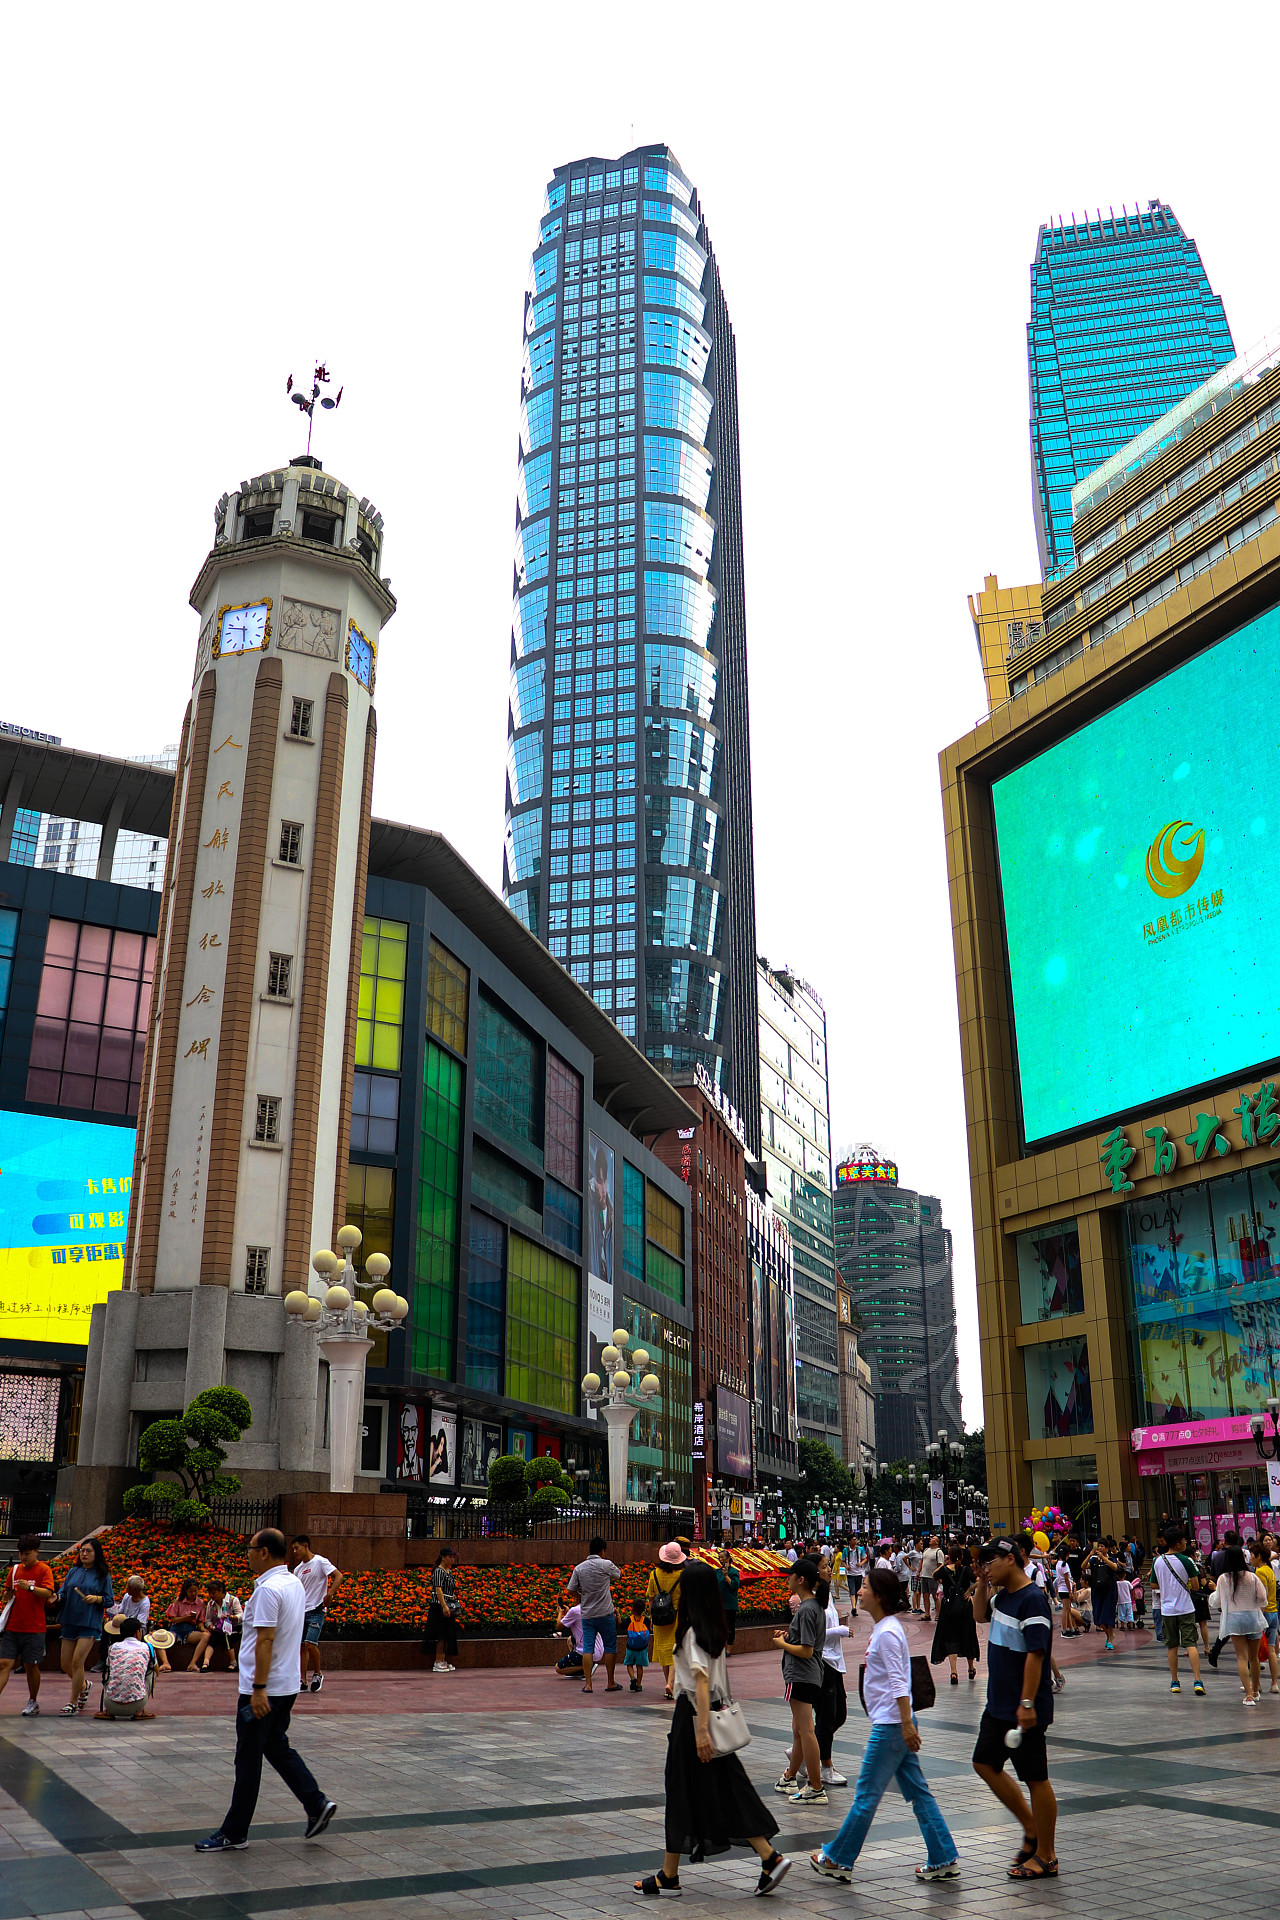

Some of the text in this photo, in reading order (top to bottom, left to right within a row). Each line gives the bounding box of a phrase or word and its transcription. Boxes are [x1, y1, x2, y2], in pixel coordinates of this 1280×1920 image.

[1143, 889, 1224, 940] 凤凰都市传媒
[839, 1165, 896, 1182] 得意美食城
[69, 1211, 124, 1229] 可观影
[1140, 1205, 1183, 1232] OLAY
[663, 1328, 690, 1352] ME&CITY
[693, 1402, 705, 1446] 希岸酒店
[933, 1491, 942, 1500] 5G
[948, 1491, 957, 1500] 5G
